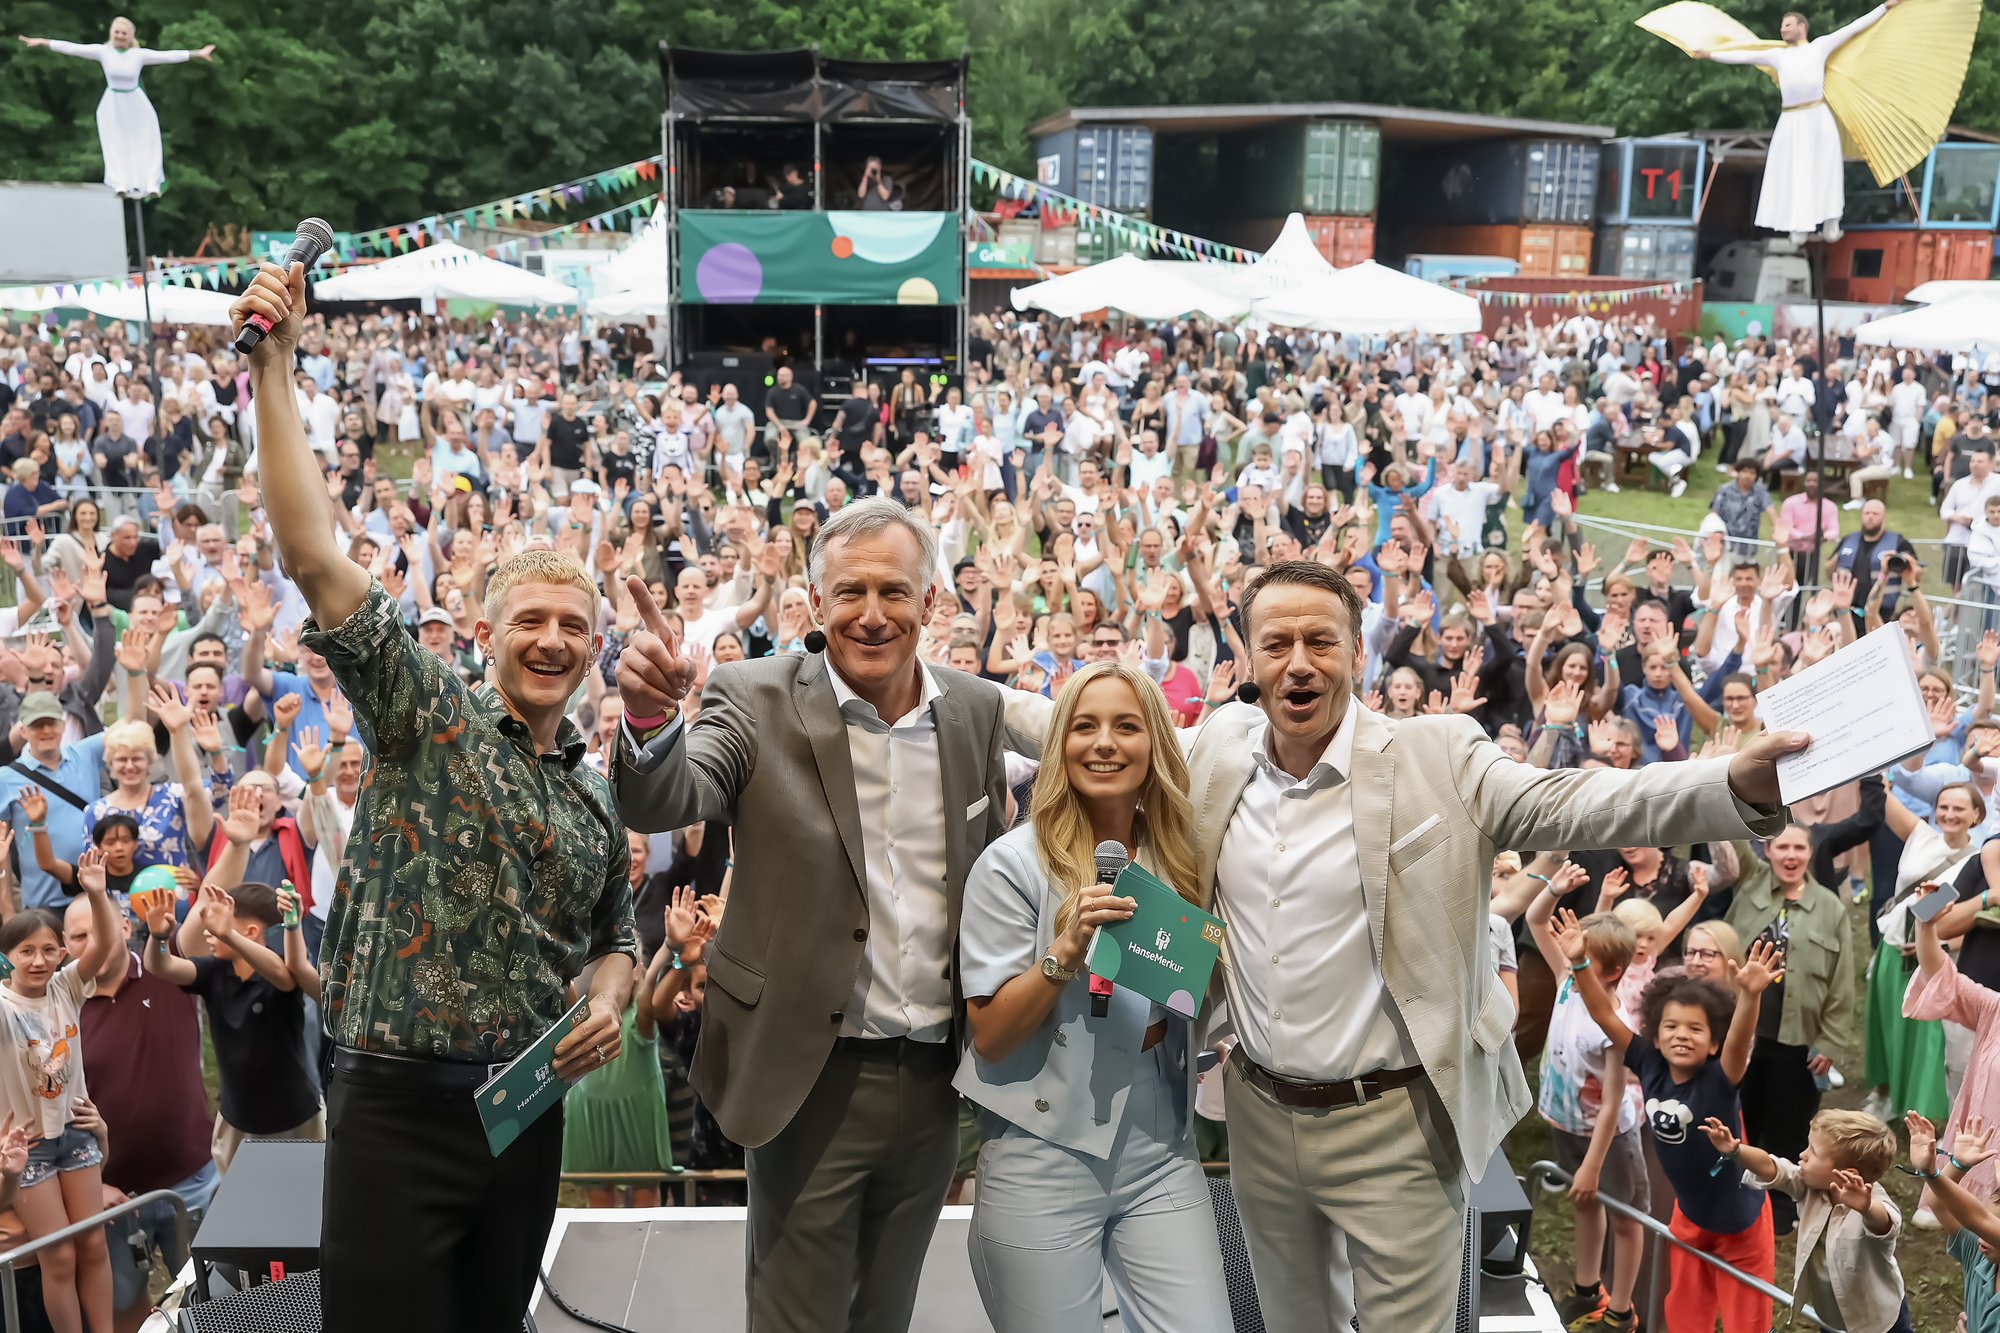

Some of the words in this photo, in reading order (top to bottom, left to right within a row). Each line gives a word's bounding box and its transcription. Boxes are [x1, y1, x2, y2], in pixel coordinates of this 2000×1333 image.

[1640, 168, 1681, 201] T1
[1205, 924, 1221, 938] 150
[1128, 941, 1184, 974] HanseMerkur
[571, 1006, 586, 1024] 150
[516, 1074, 555, 1111] HanseMe
